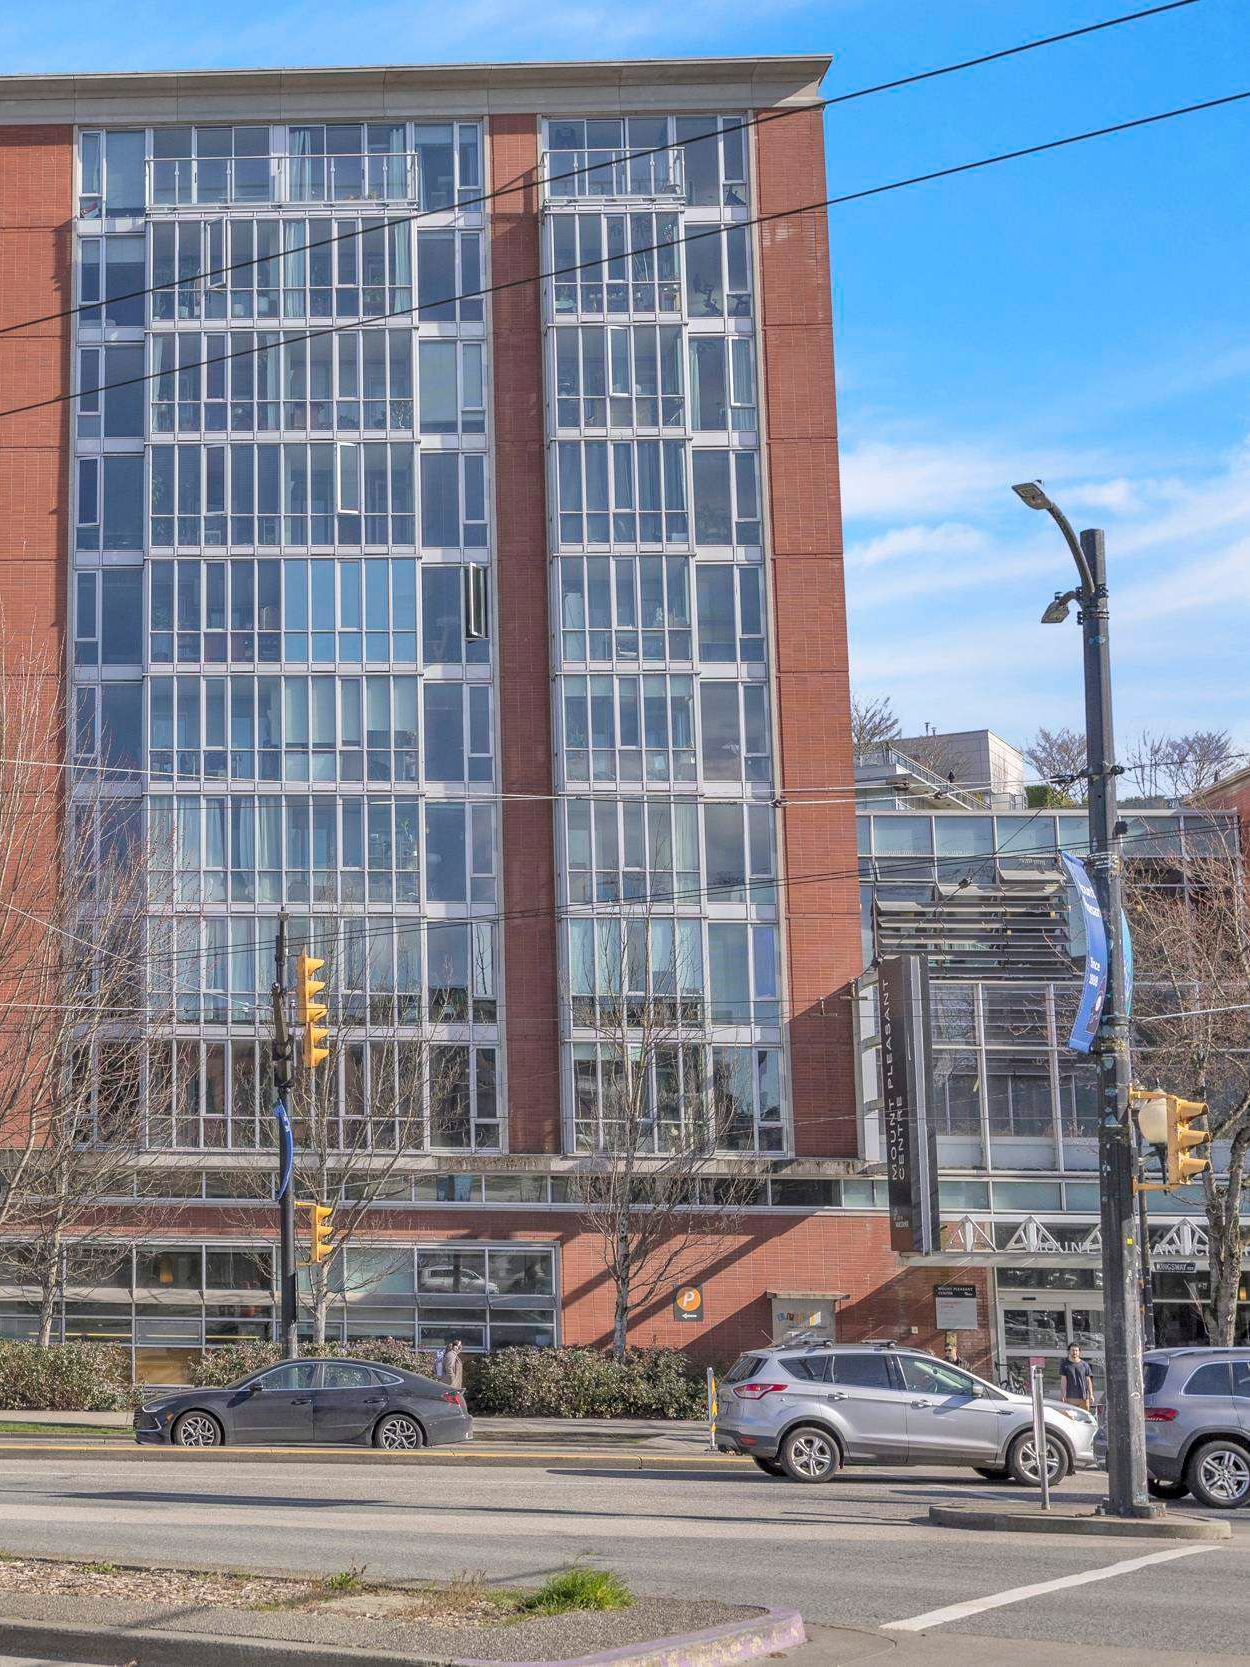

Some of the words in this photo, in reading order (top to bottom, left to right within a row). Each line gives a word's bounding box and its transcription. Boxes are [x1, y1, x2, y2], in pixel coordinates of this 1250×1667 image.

[882, 979, 894, 1089] PLEASANT
[889, 1099, 897, 1180] MOUNT
[896, 1096, 905, 1180] CENTRE
[683, 1291, 695, 1307] P
